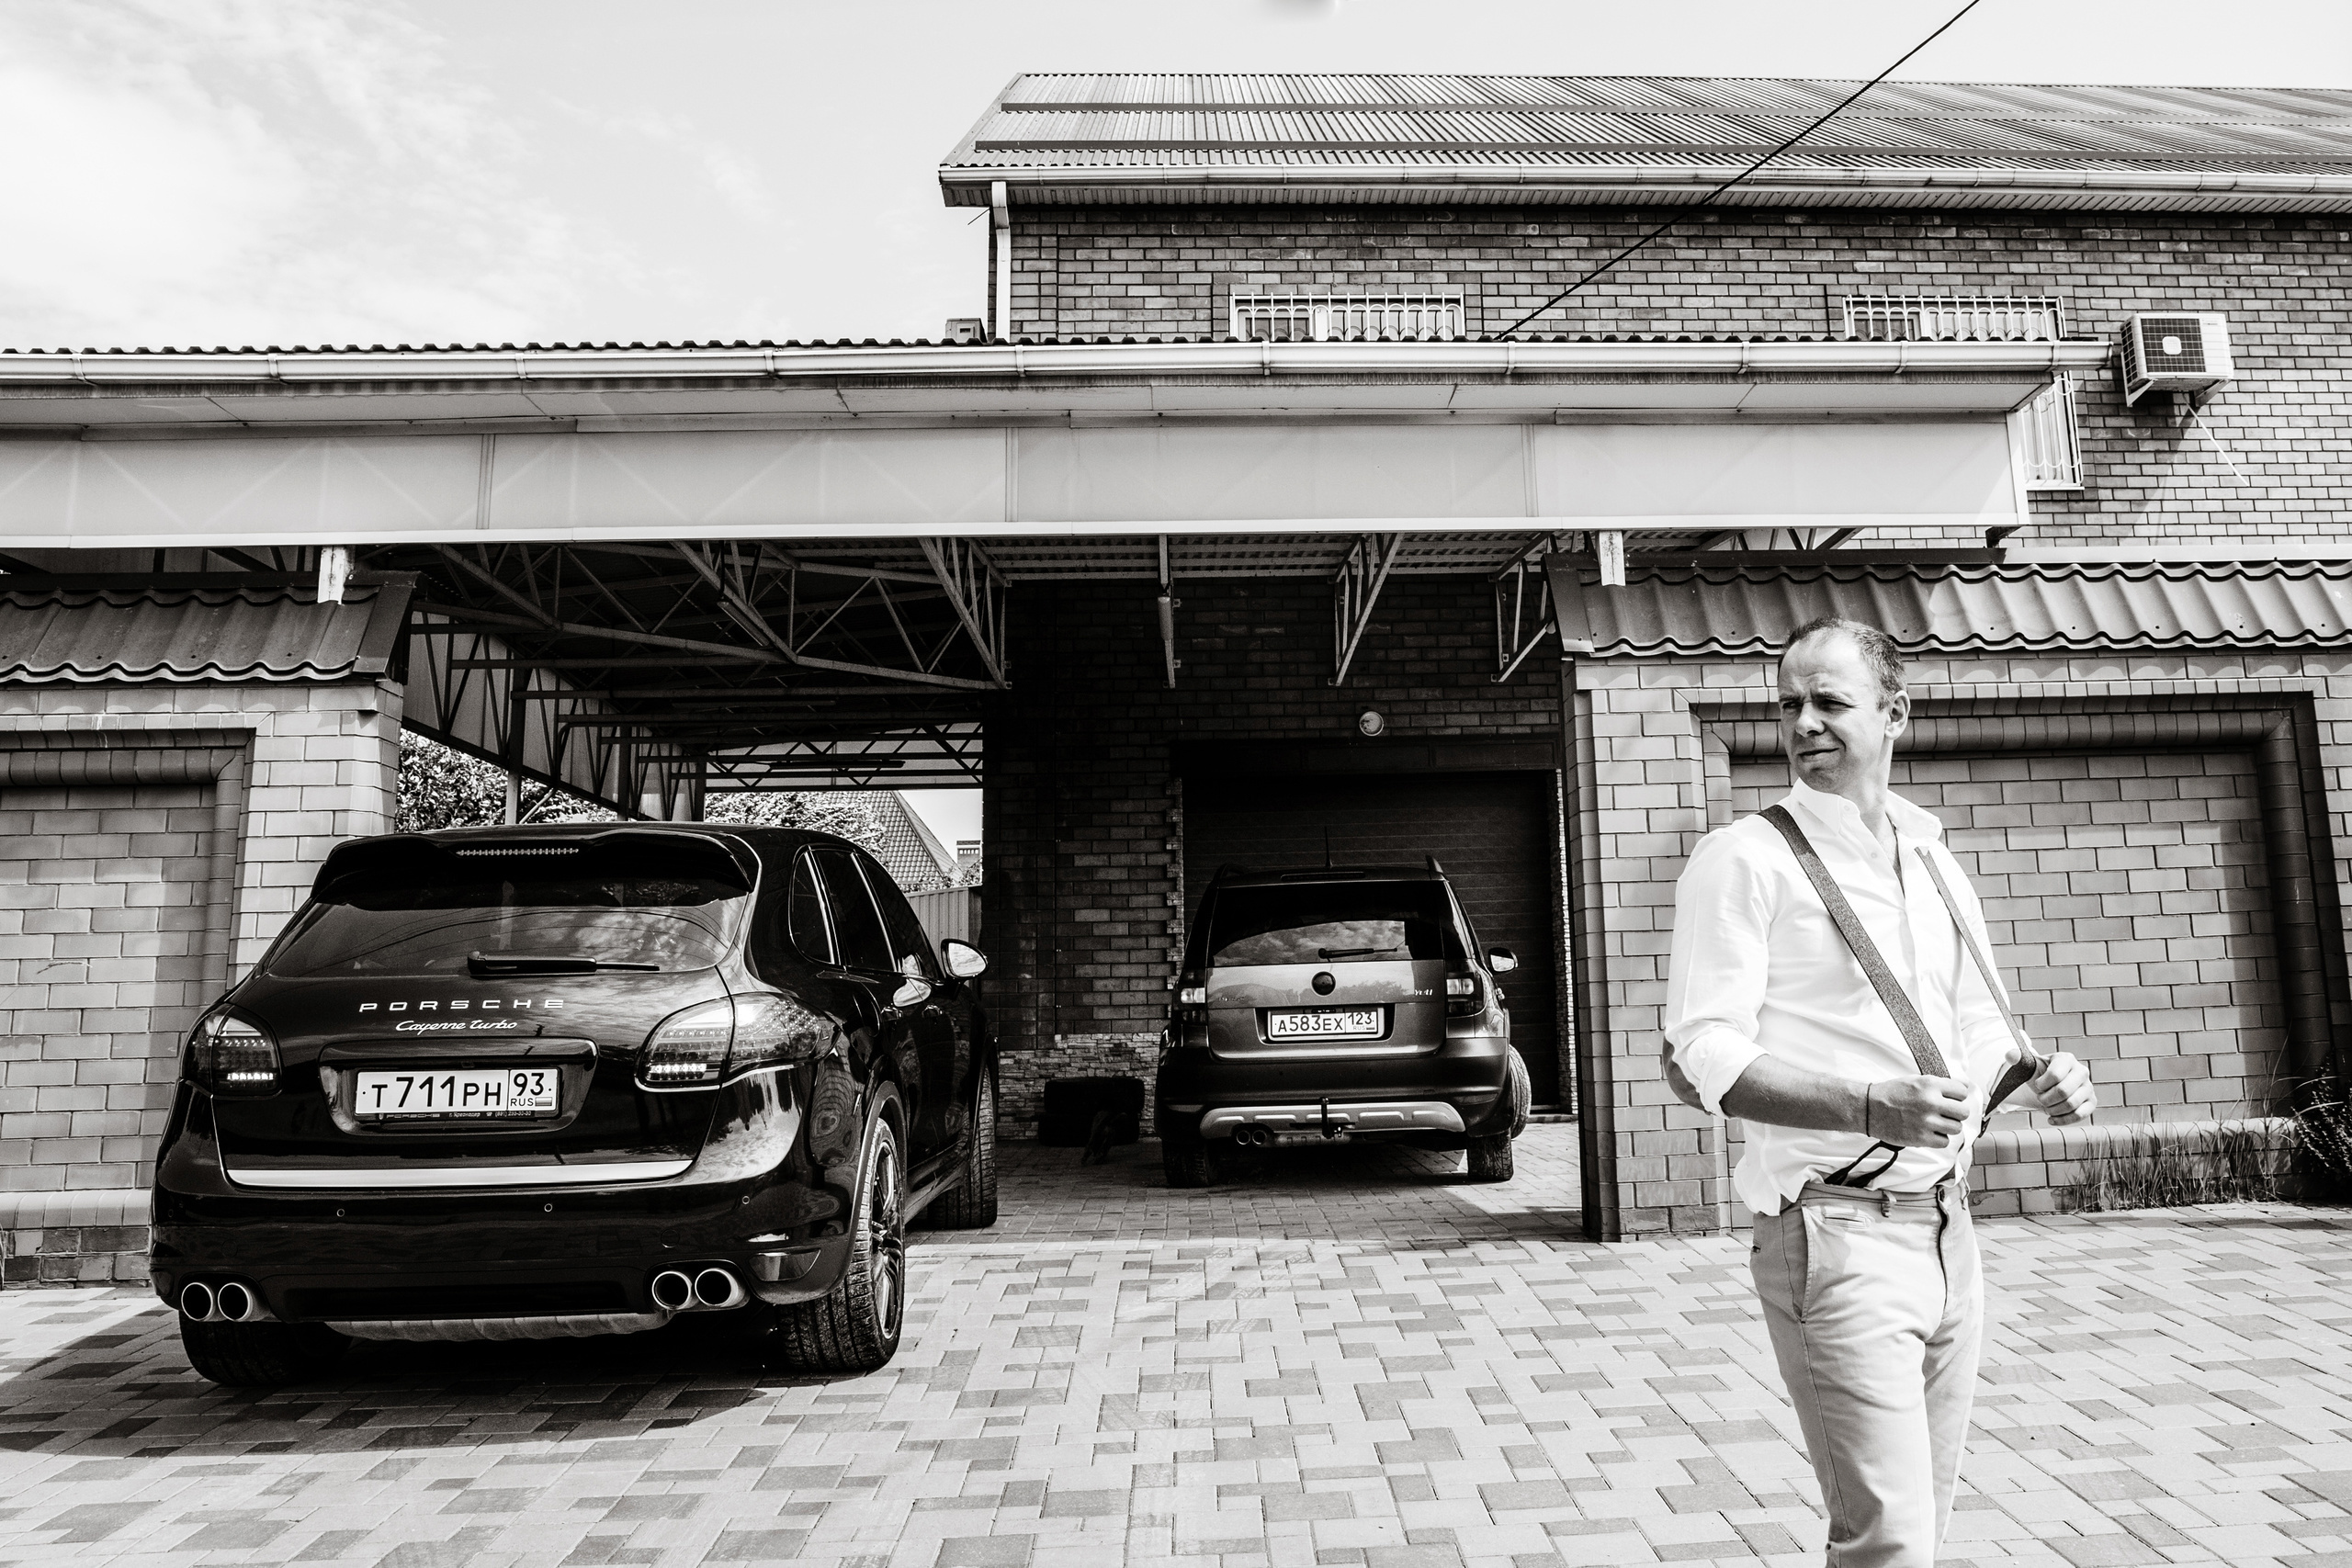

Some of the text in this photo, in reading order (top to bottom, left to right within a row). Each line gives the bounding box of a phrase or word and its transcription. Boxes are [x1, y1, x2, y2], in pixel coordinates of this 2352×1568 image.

[358, 999, 564, 1013] PORSCHE
[1347, 1011, 1373, 1025] 123
[395, 1020, 517, 1035] Cayenne turbo
[513, 1072, 545, 1097] 93
[510, 1097, 535, 1107] RUS
